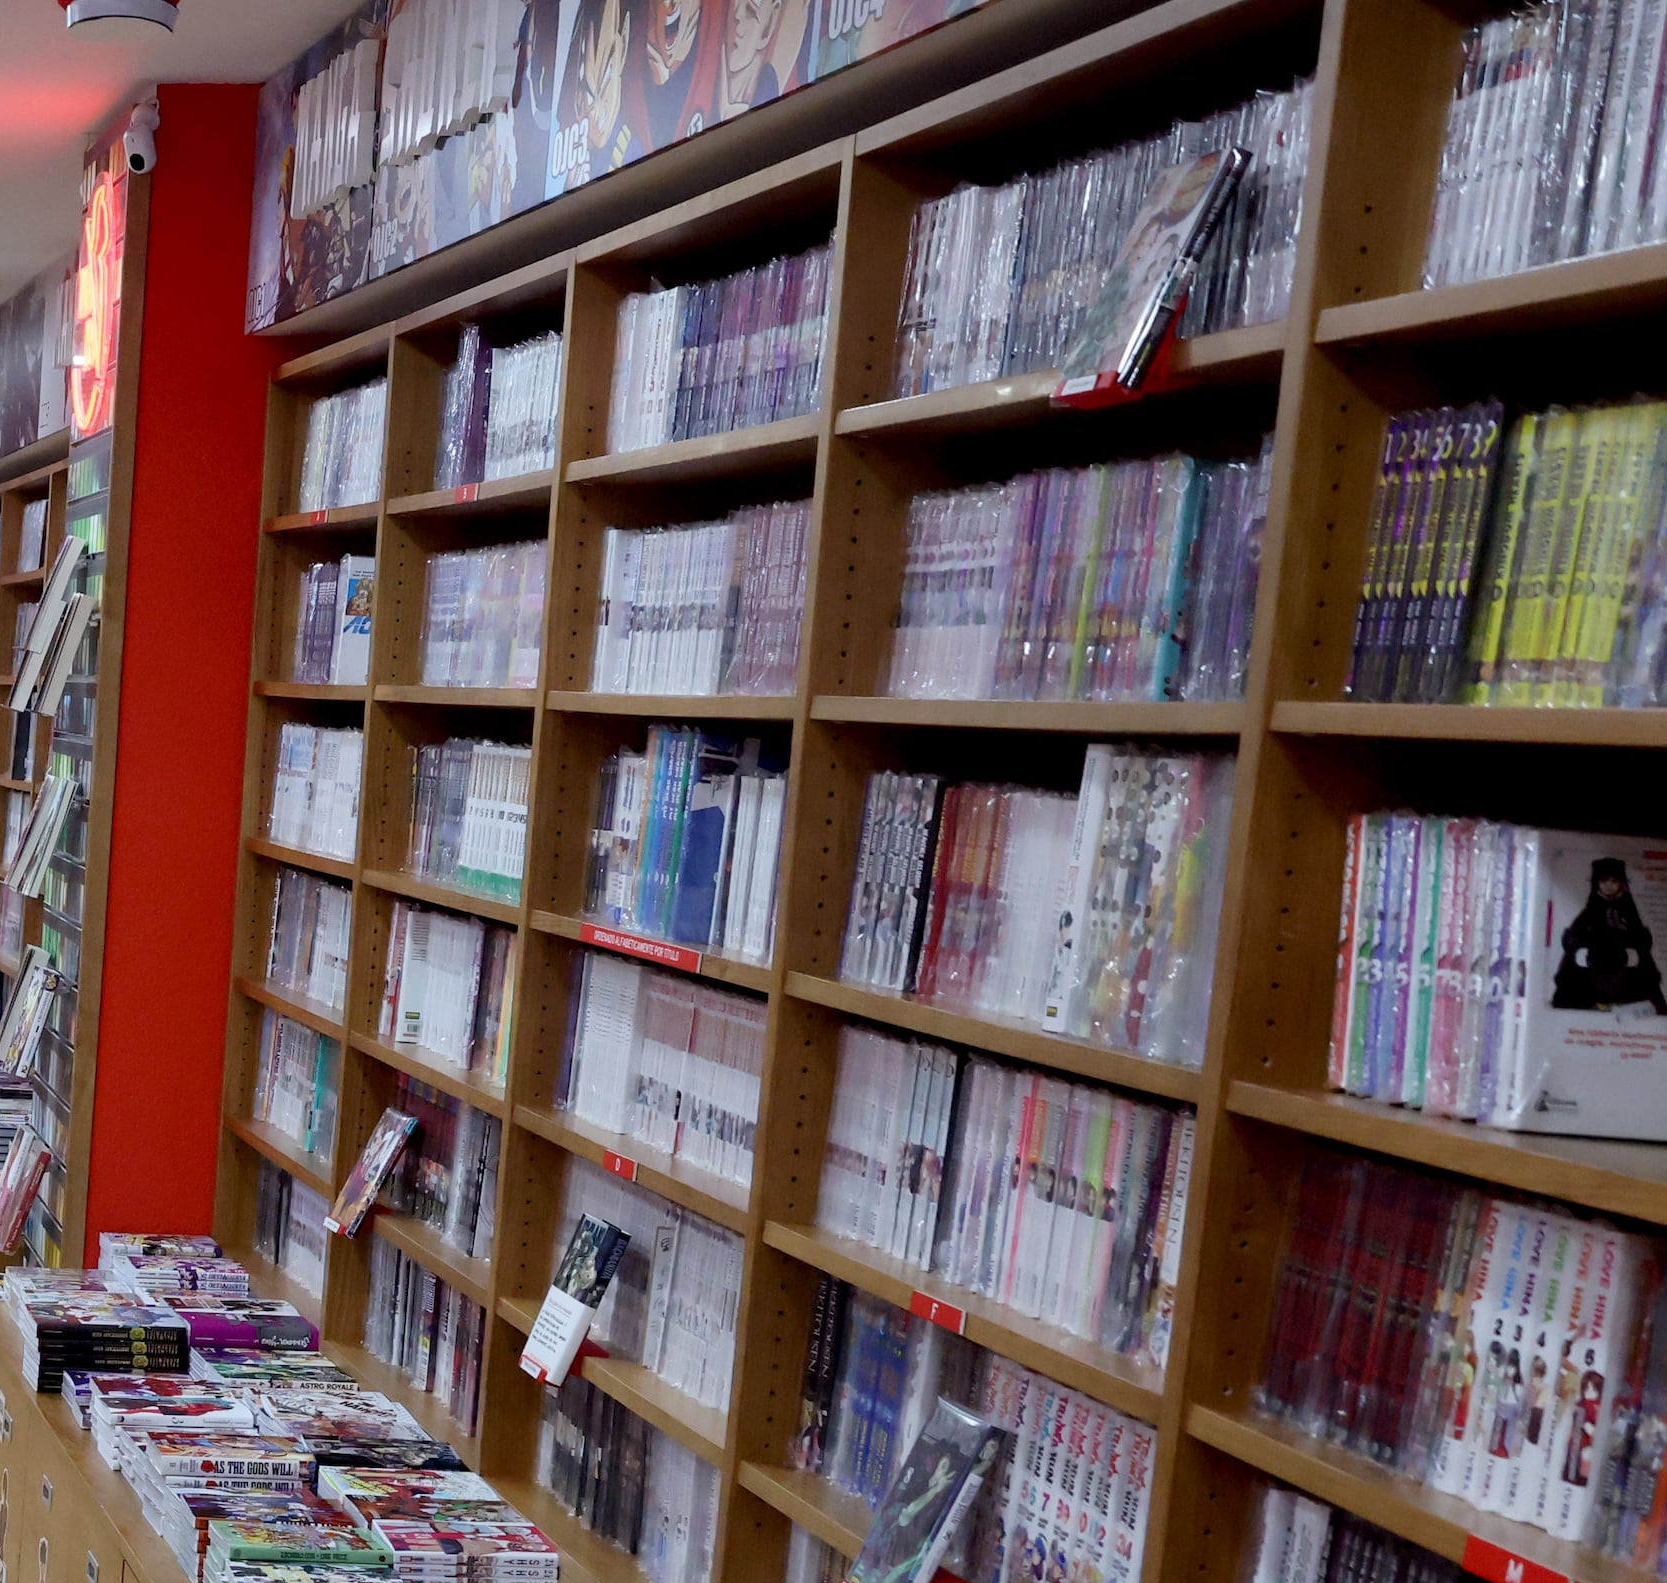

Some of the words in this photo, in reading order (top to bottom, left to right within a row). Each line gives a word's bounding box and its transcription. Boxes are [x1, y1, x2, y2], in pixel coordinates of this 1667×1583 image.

[615, 1156, 621, 1171] D
[327, 1383, 355, 1392] ROYALE
[213, 1460, 228, 1475] AS
[229, 1461, 248, 1475] THE
[249, 1460, 270, 1477] GODS
[271, 1460, 295, 1478] WILL
